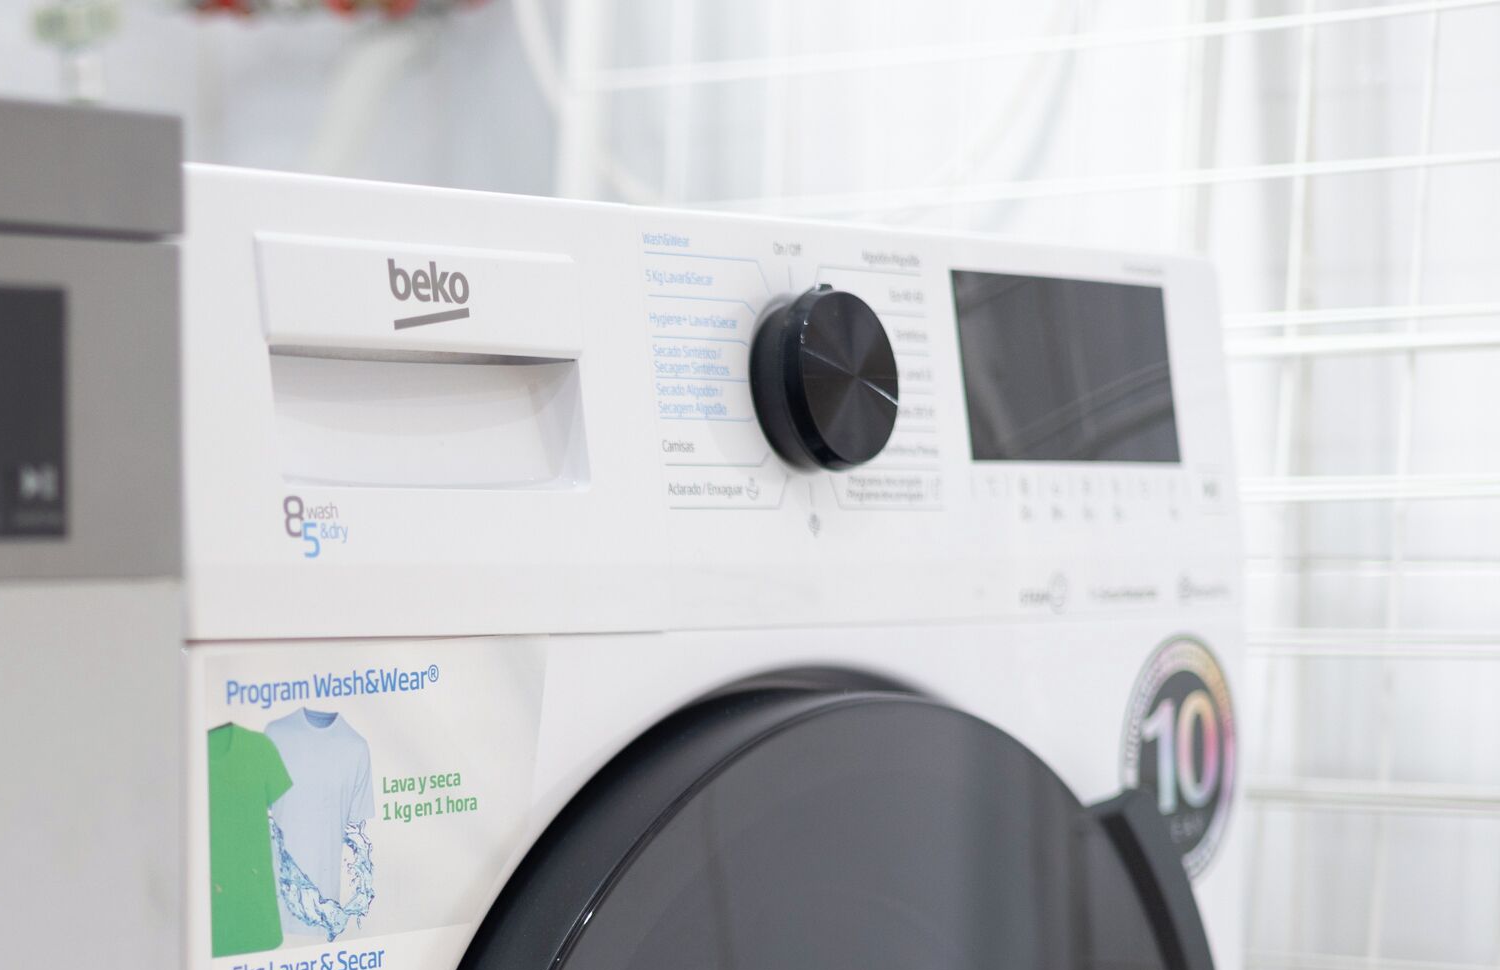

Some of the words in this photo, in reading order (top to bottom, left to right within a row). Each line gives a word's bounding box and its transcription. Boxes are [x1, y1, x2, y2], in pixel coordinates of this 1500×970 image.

[387, 258, 470, 304] beko
[653, 344, 681, 357] Secado
[655, 360, 690, 376] Secagem
[657, 383, 684, 396] Secado
[658, 401, 694, 417] Secagem
[662, 440, 695, 453] Camisas
[668, 482, 701, 496] Aclarado
[283, 495, 304, 537] 8
[307, 502, 339, 520] wash
[302, 522, 321, 558] 5
[321, 523, 349, 543] &dry
[226, 678, 309, 709] Program
[1140, 688, 1220, 816] 10
[382, 776, 415, 794] Lava
[418, 777, 427, 794] y
[430, 772, 461, 790] seca
[382, 803, 390, 821] 1
[394, 801, 412, 823] kg
[415, 802, 432, 817] en
[435, 799, 443, 815] 1
[446, 795, 477, 814] hora
